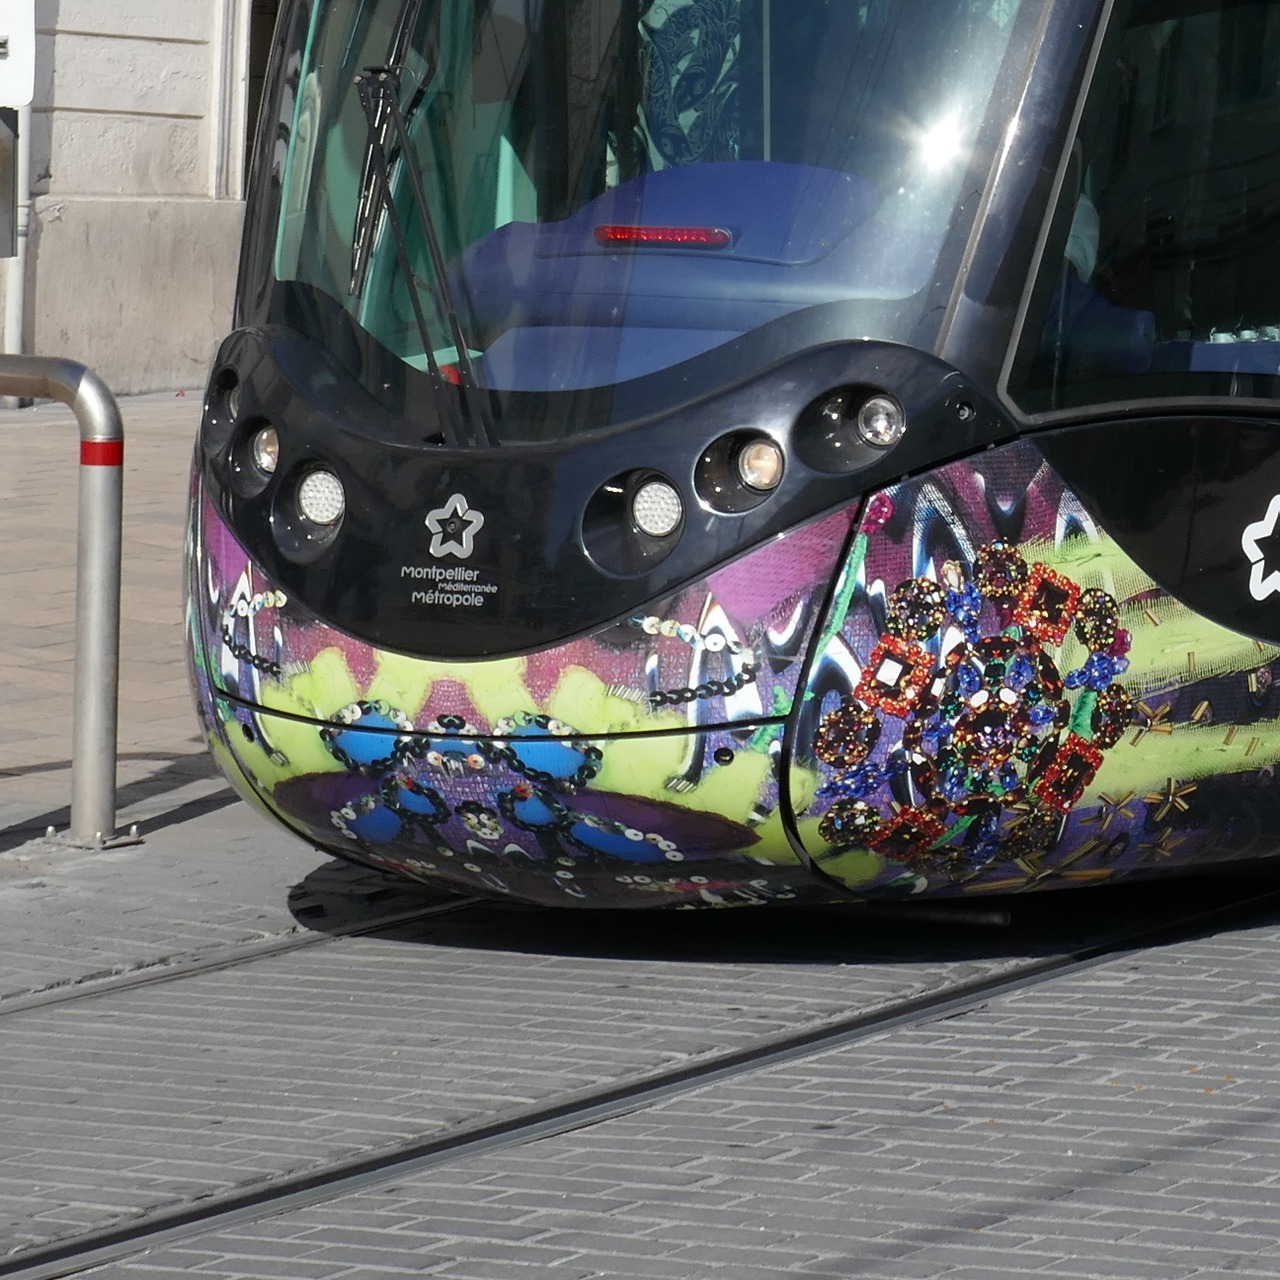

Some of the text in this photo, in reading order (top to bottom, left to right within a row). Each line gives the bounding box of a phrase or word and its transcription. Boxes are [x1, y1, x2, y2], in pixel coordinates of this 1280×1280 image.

[401, 565, 480, 582] Montpellier
[438, 581, 498, 594] Méditerranée
[412, 589, 484, 608] Métropole
